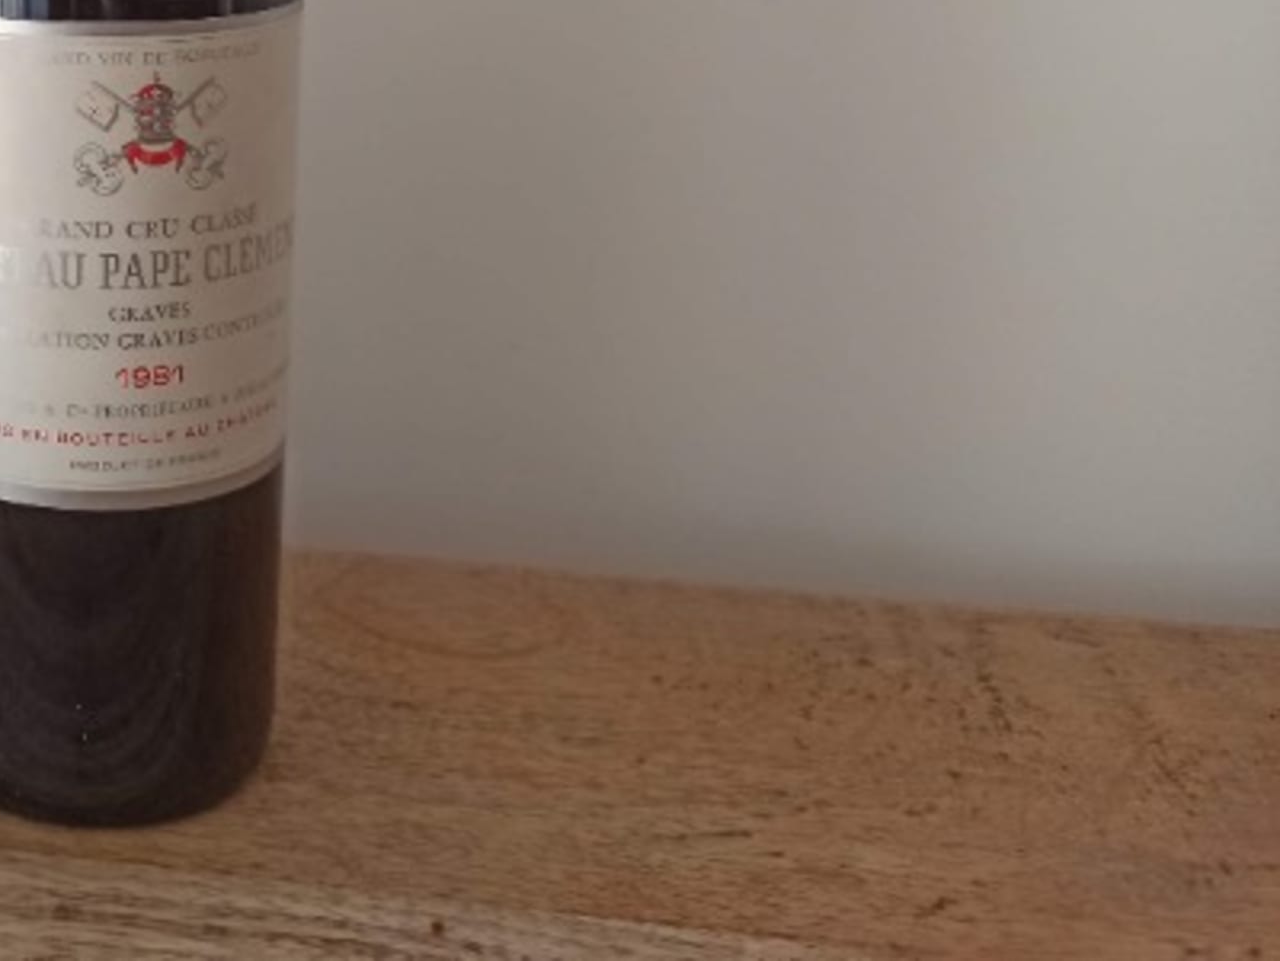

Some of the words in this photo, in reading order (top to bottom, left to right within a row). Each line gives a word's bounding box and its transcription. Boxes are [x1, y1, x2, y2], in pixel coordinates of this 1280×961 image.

[124, 217, 180, 240] CRU
[98, 250, 192, 290] PAPE
[106, 301, 192, 323] GRAVES
[116, 328, 198, 352] GRAVES
[113, 363, 185, 390] 1981
[20, 428, 49, 444] EN
[56, 429, 177, 448] BOUTEILLE
[184, 423, 210, 439] AU
